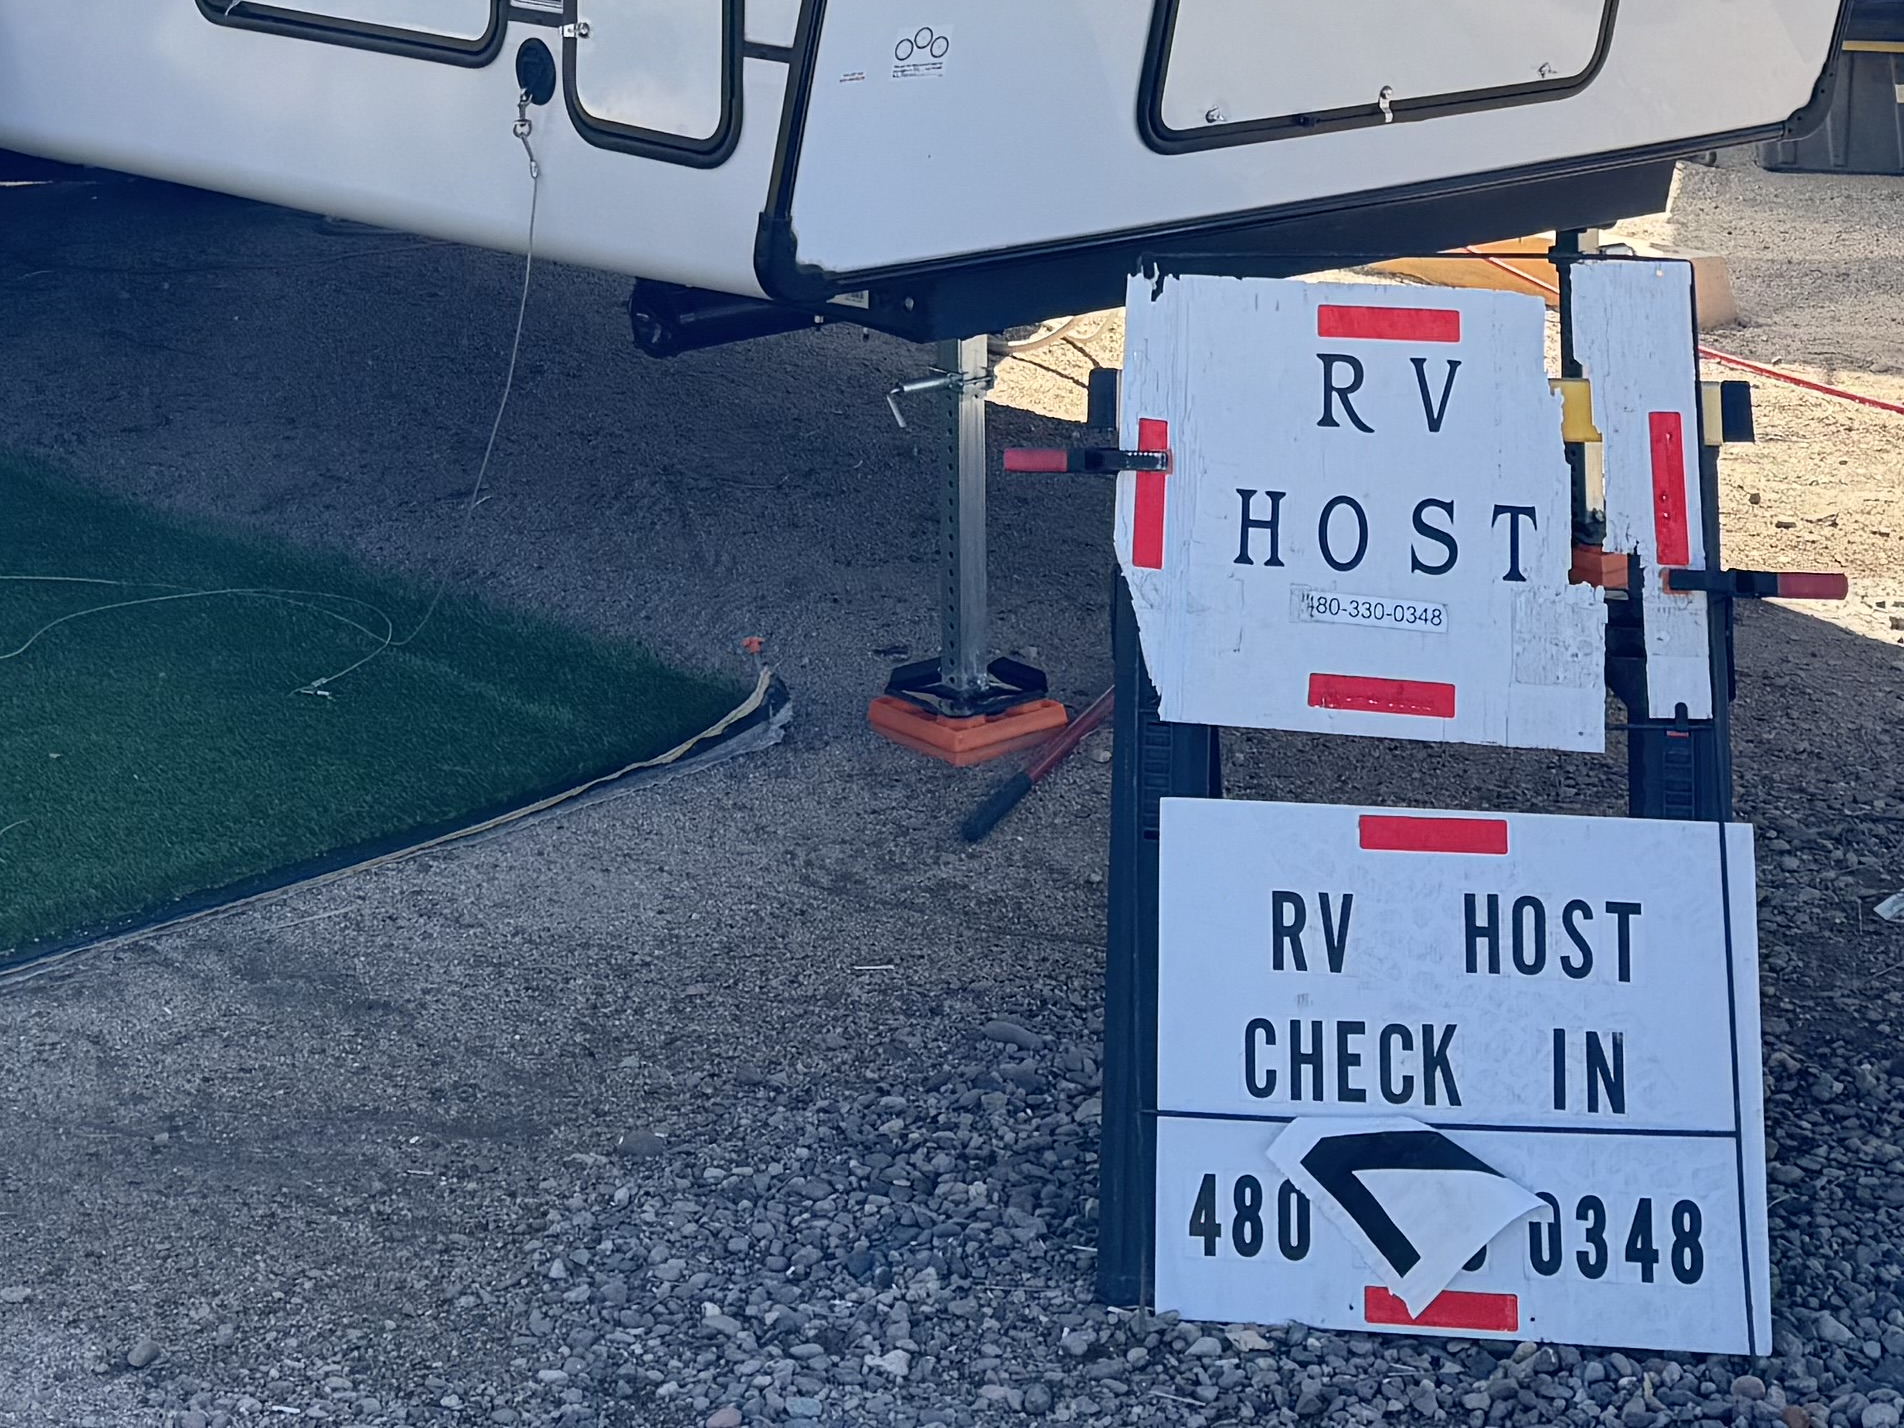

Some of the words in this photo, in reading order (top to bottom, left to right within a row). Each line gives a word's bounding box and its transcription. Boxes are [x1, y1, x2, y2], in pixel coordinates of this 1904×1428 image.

[1233, 488, 1537, 582] HOST
[1271, 890, 1354, 973] RV
[1463, 893, 1642, 982] HOST
[1244, 1017, 1462, 1107] CHECK
[1553, 1028, 1626, 1114] IN
[1189, 1173, 1312, 1261] 480
